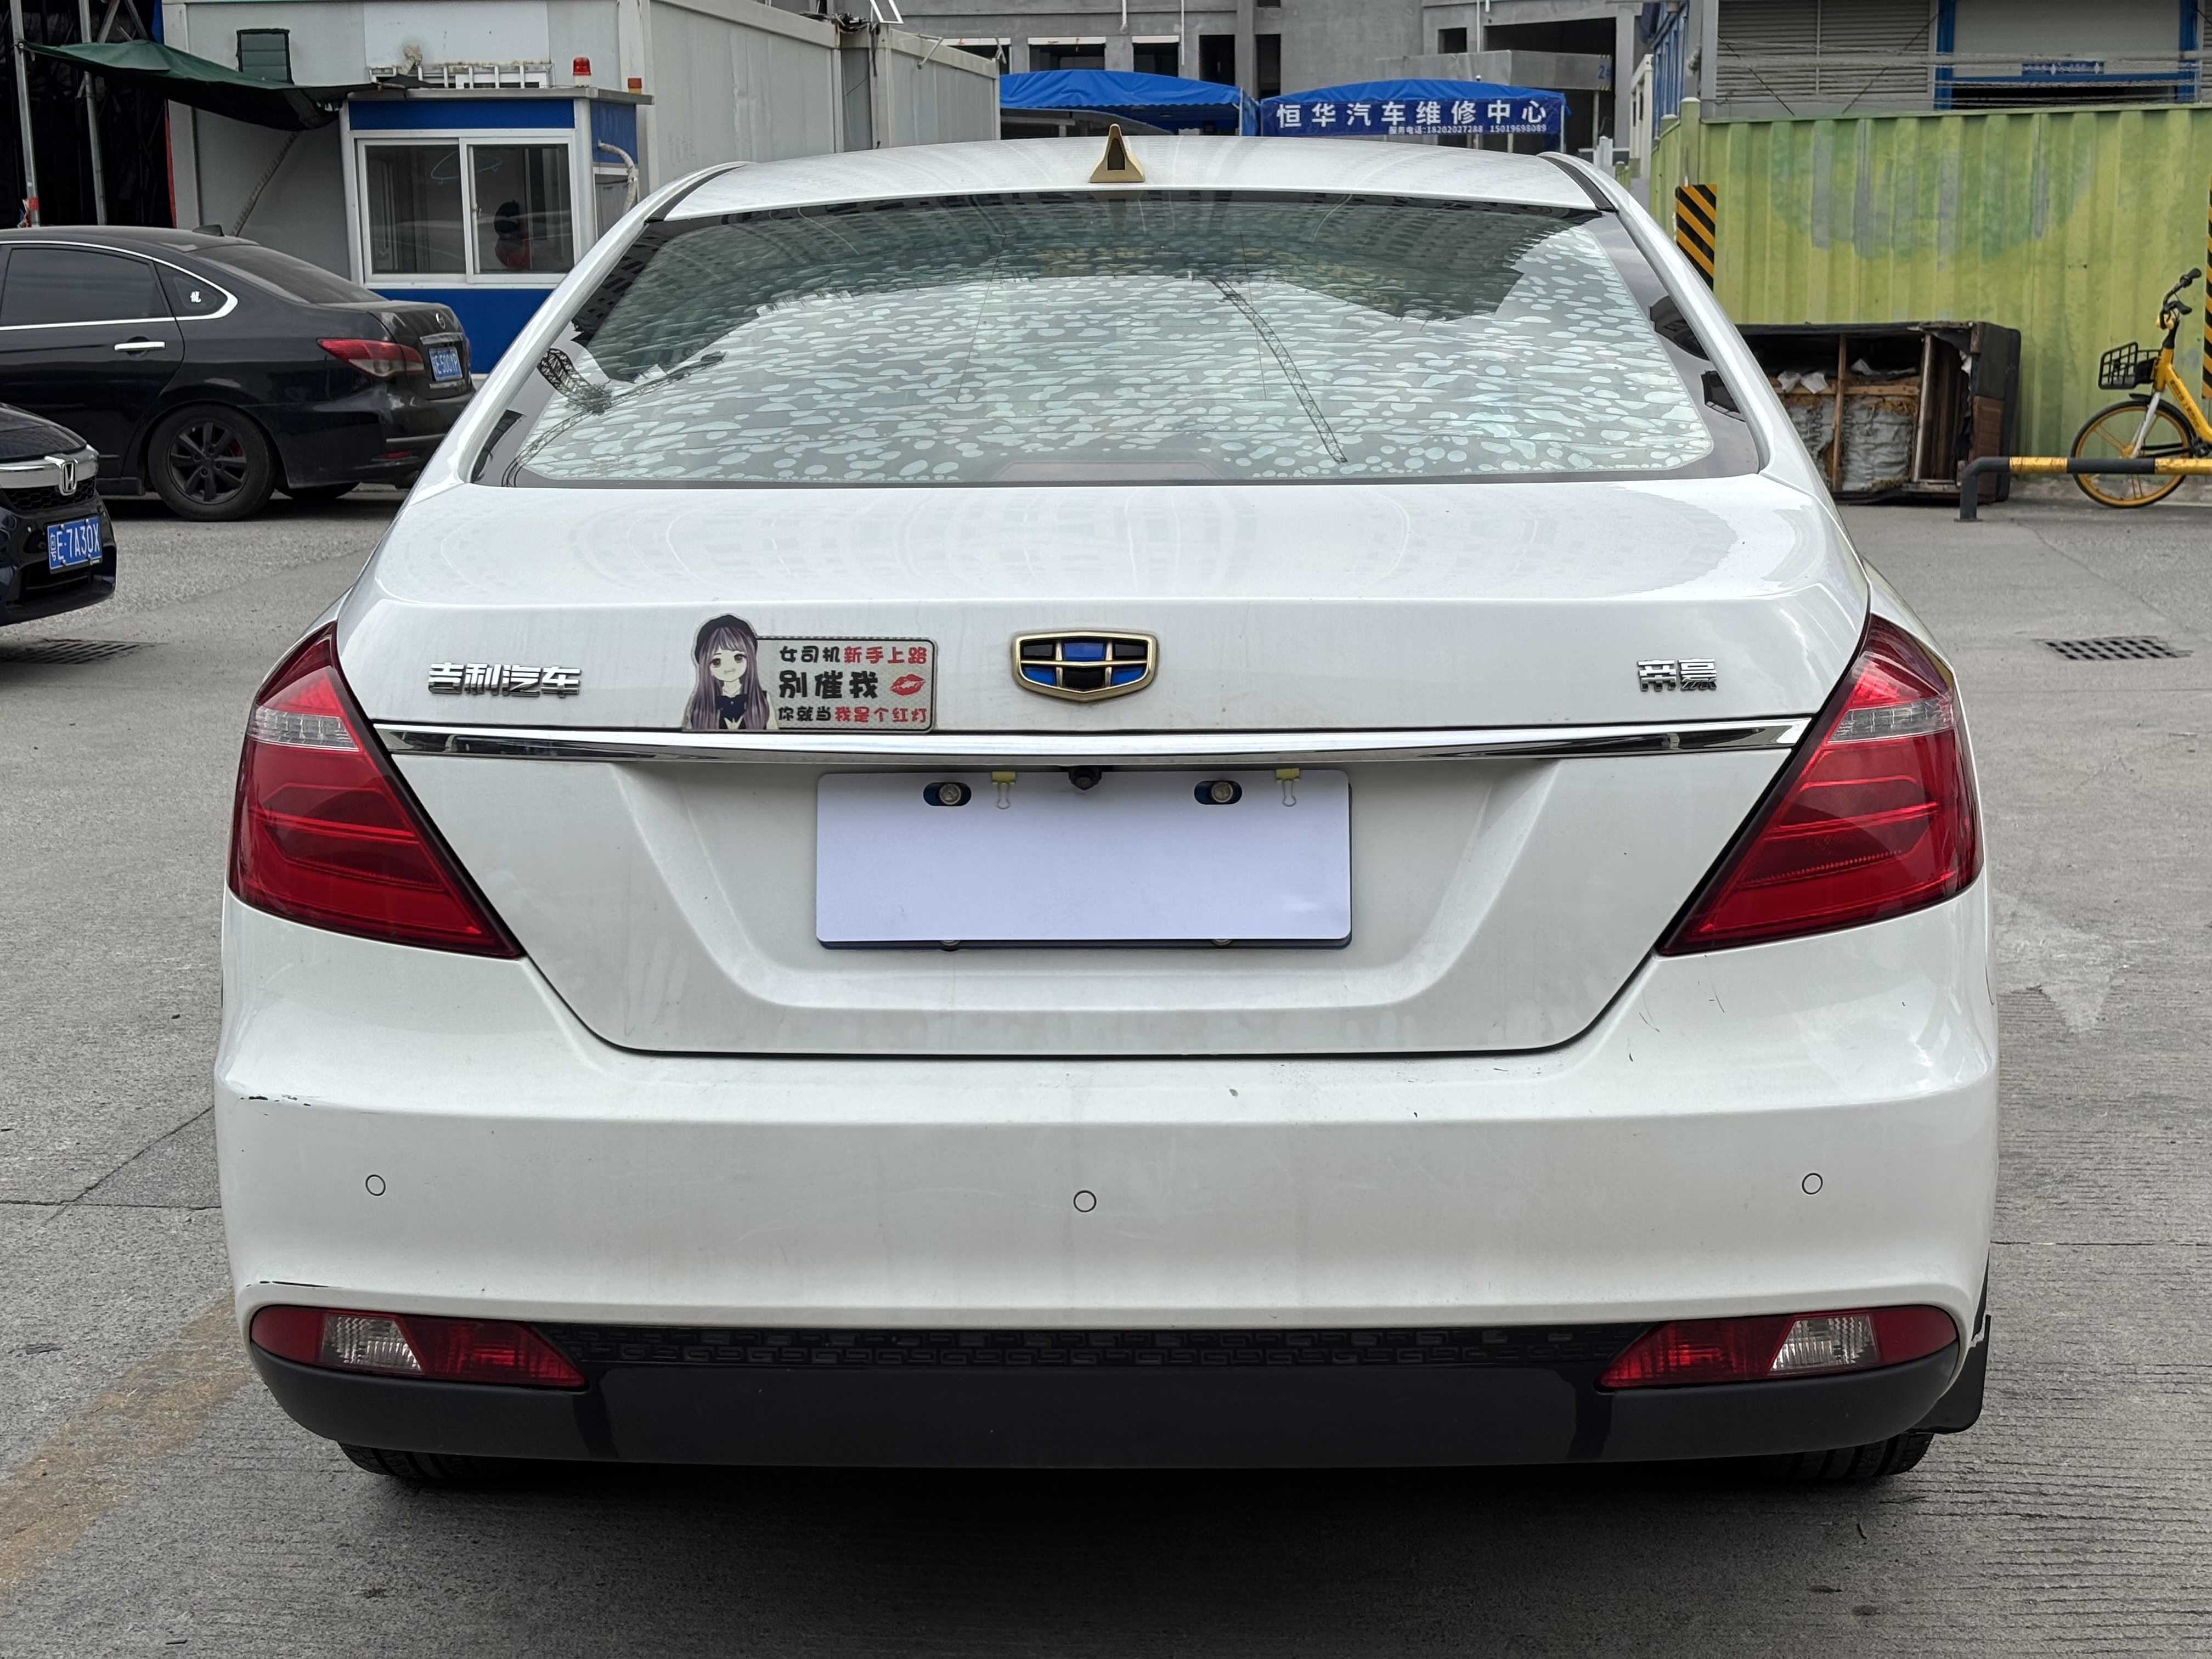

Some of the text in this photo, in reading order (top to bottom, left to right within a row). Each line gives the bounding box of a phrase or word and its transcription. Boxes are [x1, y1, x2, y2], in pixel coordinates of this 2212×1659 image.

[1276, 100, 1547, 128] 恒华汽车维修中心
[779, 646, 928, 665] 女司机新手上路
[428, 662, 582, 698] 吉利汽车
[779, 670, 878, 699] 别催我
[1637, 658, 1718, 692] 帝豪
[778, 706, 927, 723] 你就当我是个红灯
